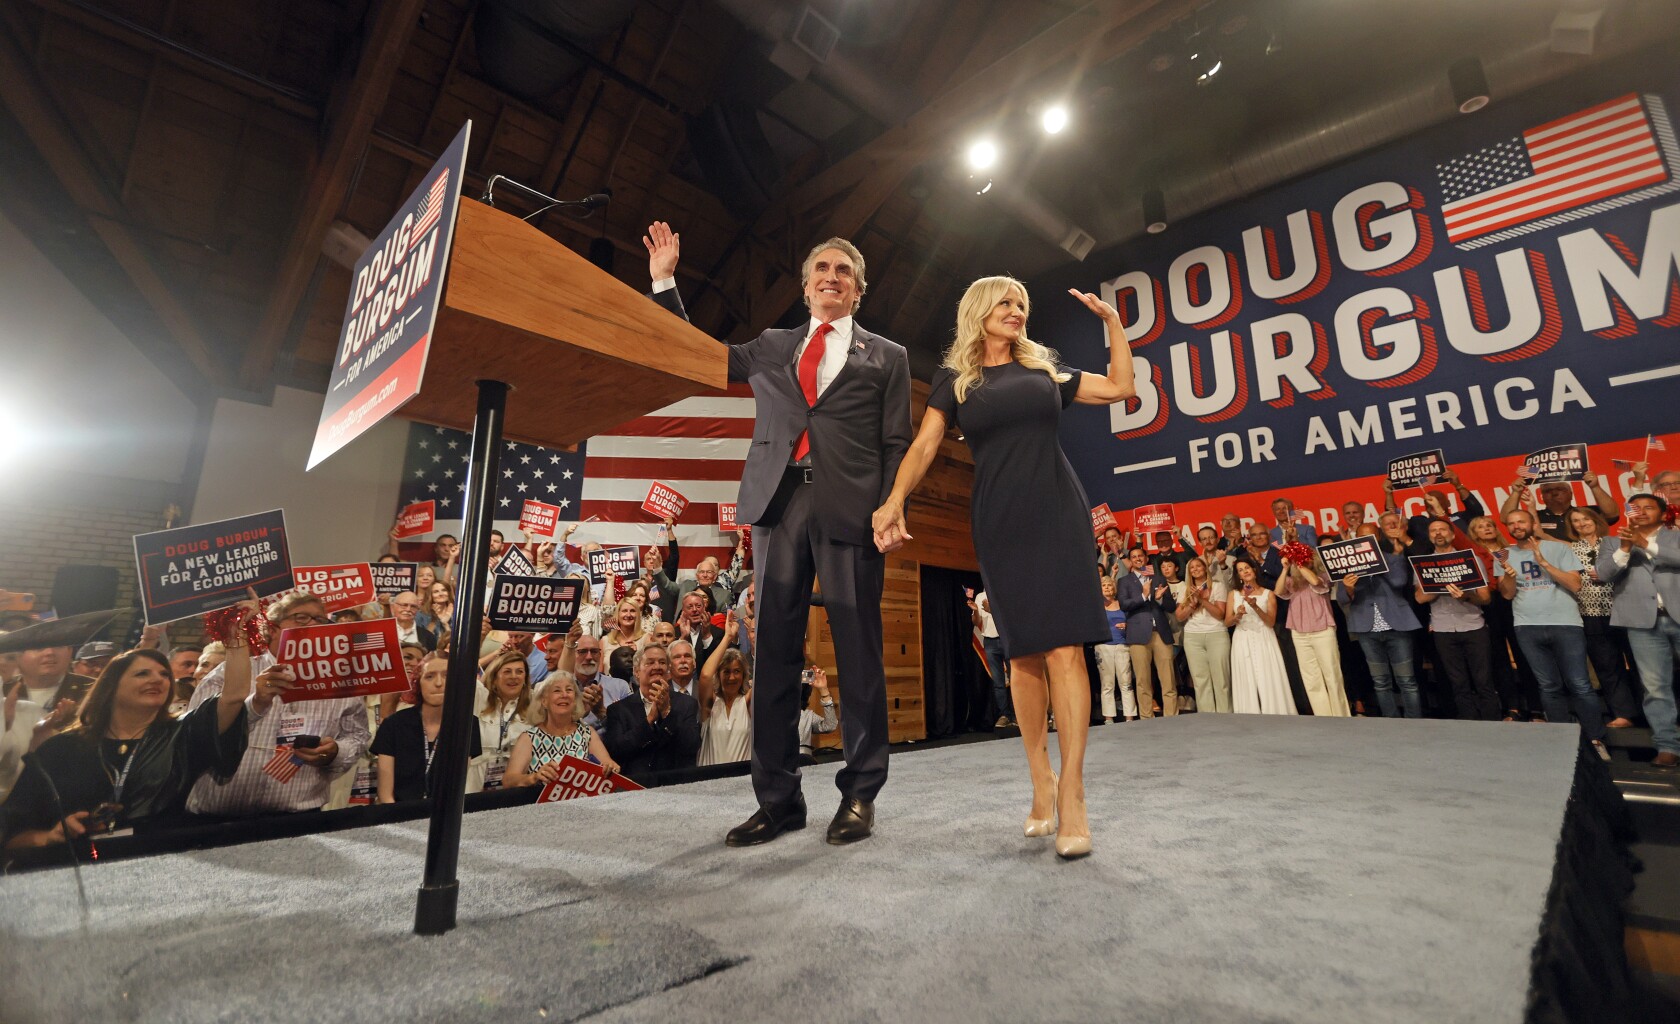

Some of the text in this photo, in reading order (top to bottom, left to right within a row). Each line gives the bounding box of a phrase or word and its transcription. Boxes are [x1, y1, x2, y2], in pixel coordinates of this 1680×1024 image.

[351, 212, 414, 315] DOUG
[1100, 180, 1430, 349] DOUG
[339, 226, 439, 368] BURGUM
[1107, 203, 1680, 437] BURGUM
[344, 315, 405, 387] FOR AMERICA
[328, 376, 399, 441] DougBurgum.com
[1187, 367, 1597, 474] FOR AMERICA
[1390, 457, 1421, 472] DOUG
[1525, 451, 1558, 467] DOUG
[1533, 459, 1582, 473] RGUM
[1390, 463, 1441, 480] BURGUM
[653, 485, 678, 503] DOUG
[649, 493, 683, 517] BURGUM
[165, 527, 269, 558] DOUG BURGUM
[1322, 544, 1355, 560] DOUG
[168, 541, 271, 573] A NEW LEADER
[509, 550, 532, 576] DOUG
[1326, 551, 1378, 570] BURGUM
[160, 550, 278, 586] FOR A CHANGING
[296, 570, 328, 583] UG
[1347, 564, 1371, 573] AMERICA
[1439, 568, 1473, 577] CHANGING
[1441, 564, 1468, 573] LEADER
[192, 566, 260, 592] ECONOMY
[296, 576, 363, 595] RGUM
[374, 576, 411, 587] RGUM
[320, 592, 348, 603] ERICA
[500, 582, 552, 600] DOUG
[496, 598, 574, 616] BURGUM
[508, 616, 558, 625] FOR AMERICA
[284, 634, 350, 660] DOUG
[306, 676, 378, 691] FOR AMERICA
[558, 765, 614, 796] DOUG
